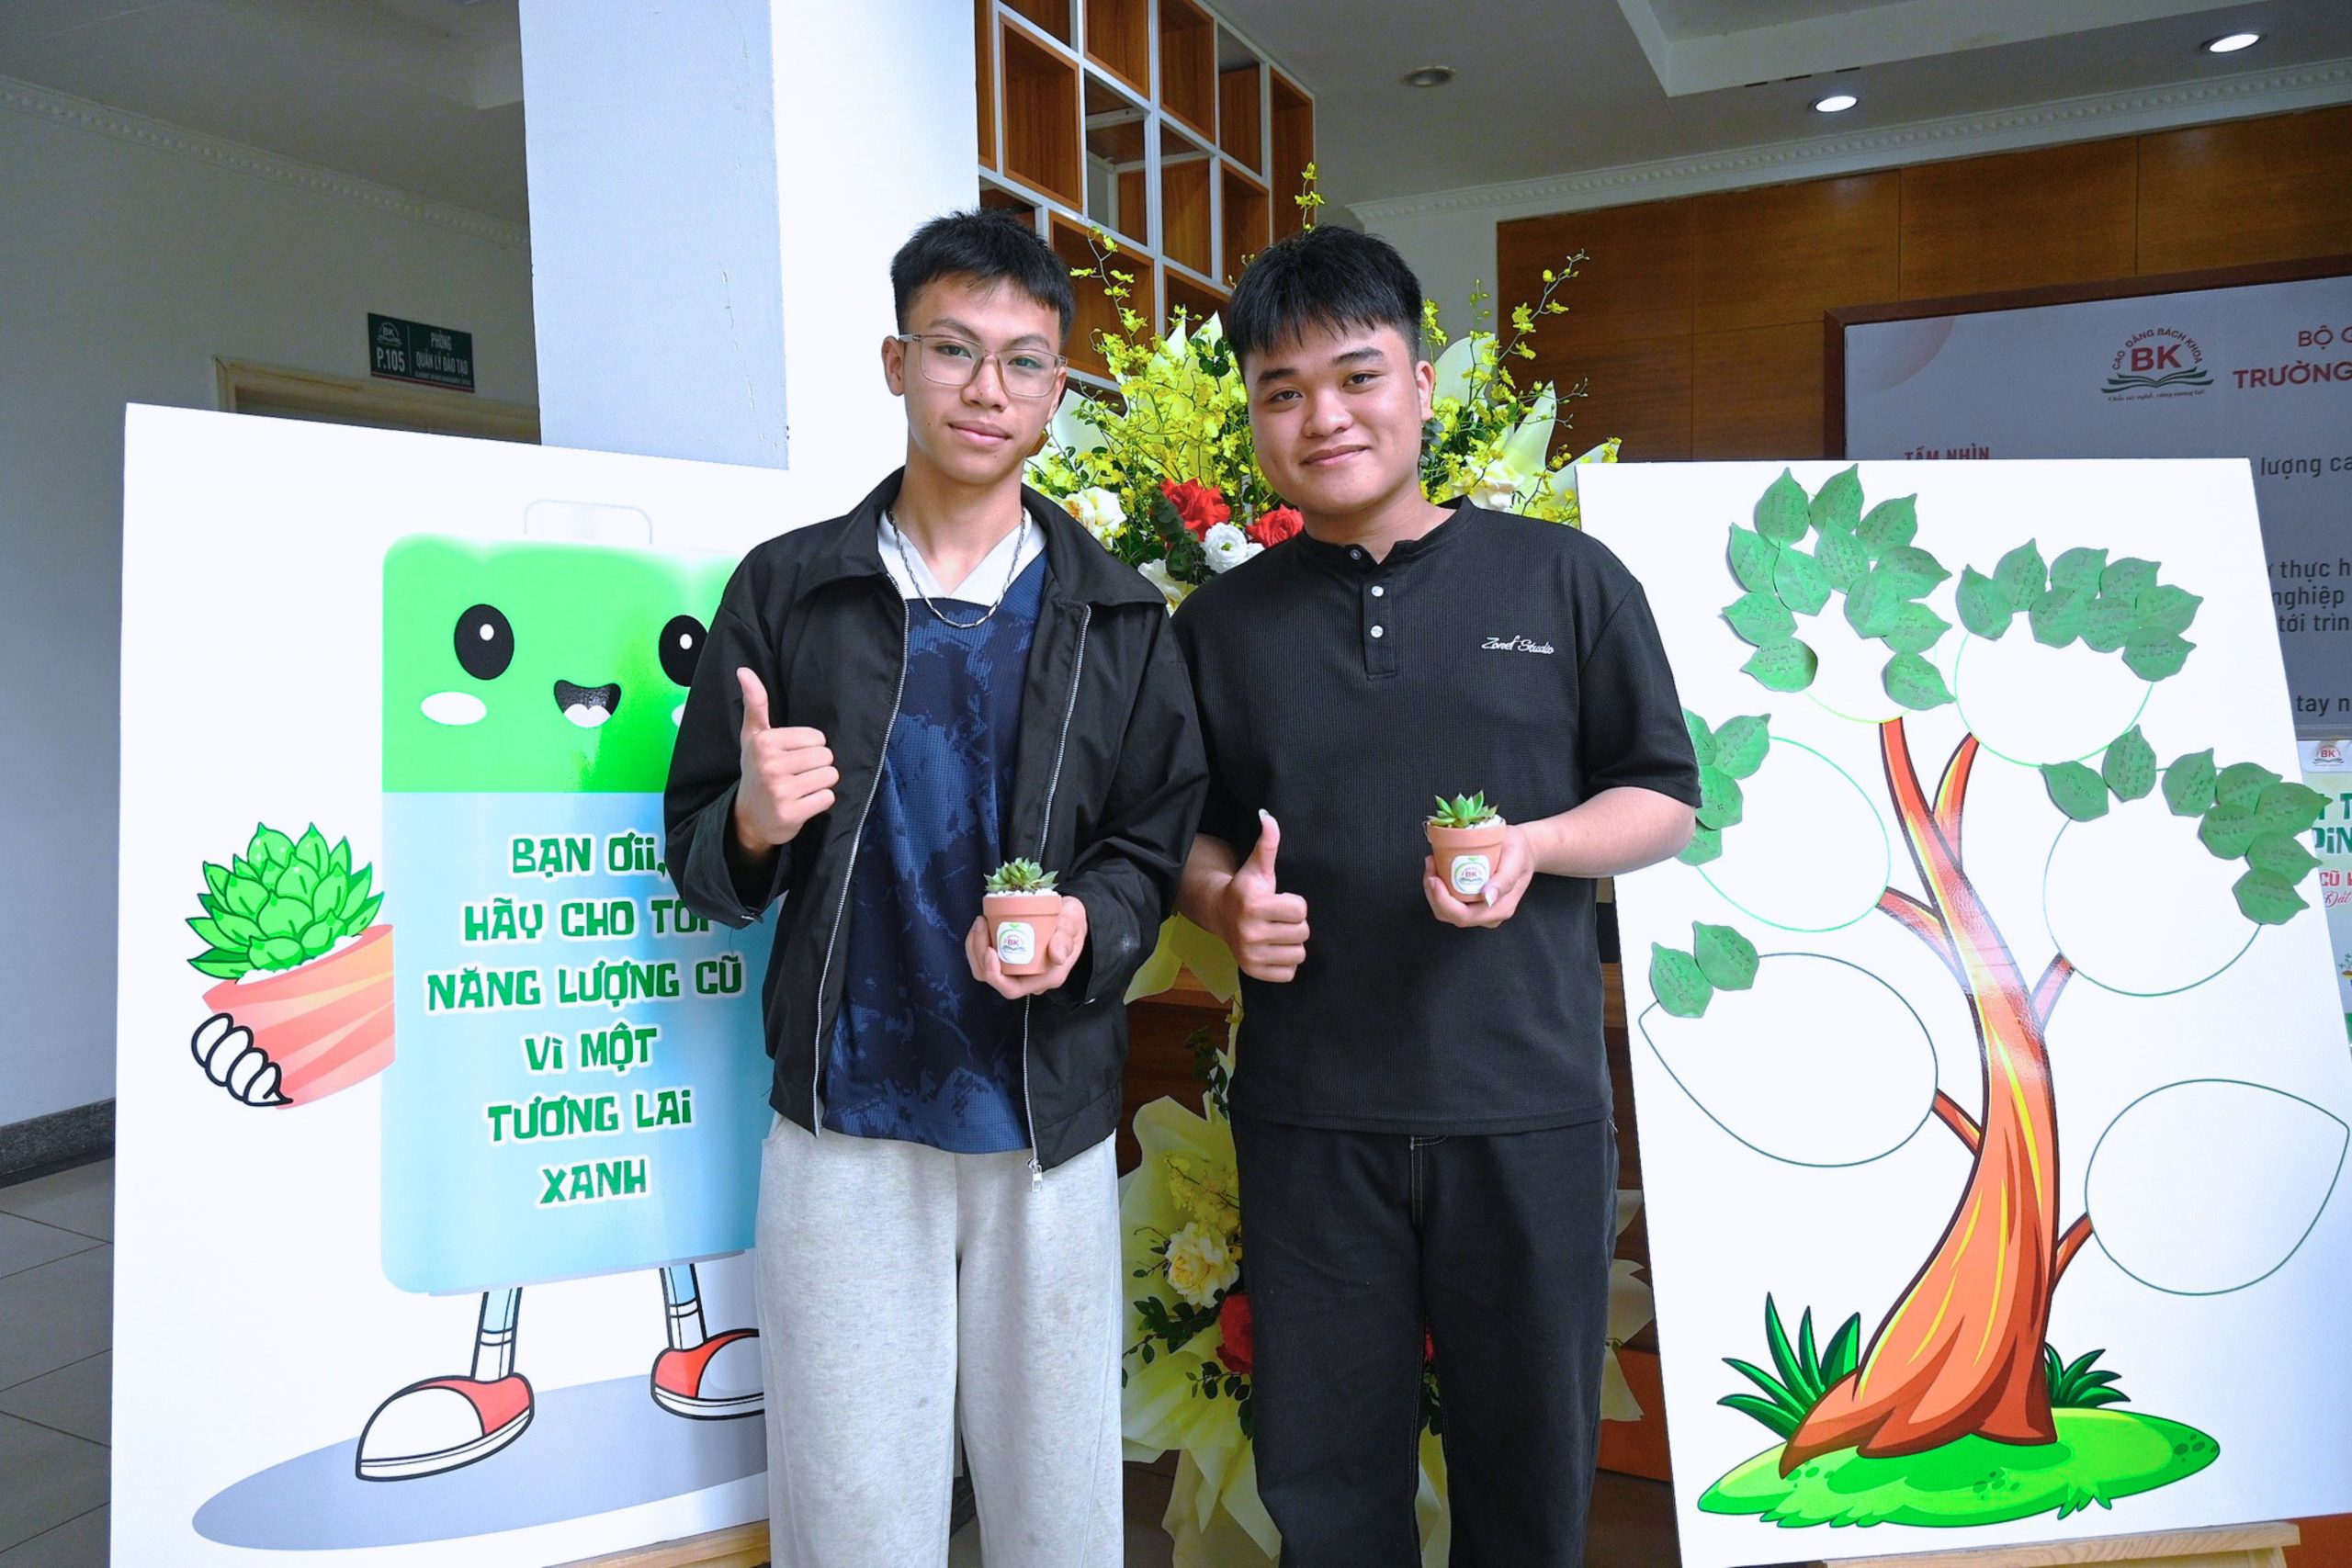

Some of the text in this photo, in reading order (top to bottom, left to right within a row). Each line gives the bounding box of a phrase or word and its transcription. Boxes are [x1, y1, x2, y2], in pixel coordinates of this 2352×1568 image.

[2299, 325, 2334, 350] BỘ
[377, 347, 405, 372] P.105
[2112, 350, 2126, 370] CAO
[2185, 338, 2203, 365] KHOA
[2132, 344, 2182, 372] BK
[2233, 360, 2352, 389] TRƯỜNG
[2261, 457, 2321, 479] lượng
[2280, 559, 2330, 582] thực
[2272, 586, 2344, 610] nghiệp
[2278, 613, 2305, 632] tới
[1518, 639, 1555, 654] Studio
[2296, 695, 2330, 716] tay
[2321, 750, 2335, 758] BK
[513, 838, 591, 878] BẠN
[464, 897, 543, 942] HÃY
[560, 900, 634, 937] CHO
[427, 955, 742, 1010] NĂNG LƯỢNG CŨ
[581, 1022, 658, 1072] MỘT
[488, 1095, 619, 1141] TƯƠNG
[540, 1158, 647, 1204] XANH
